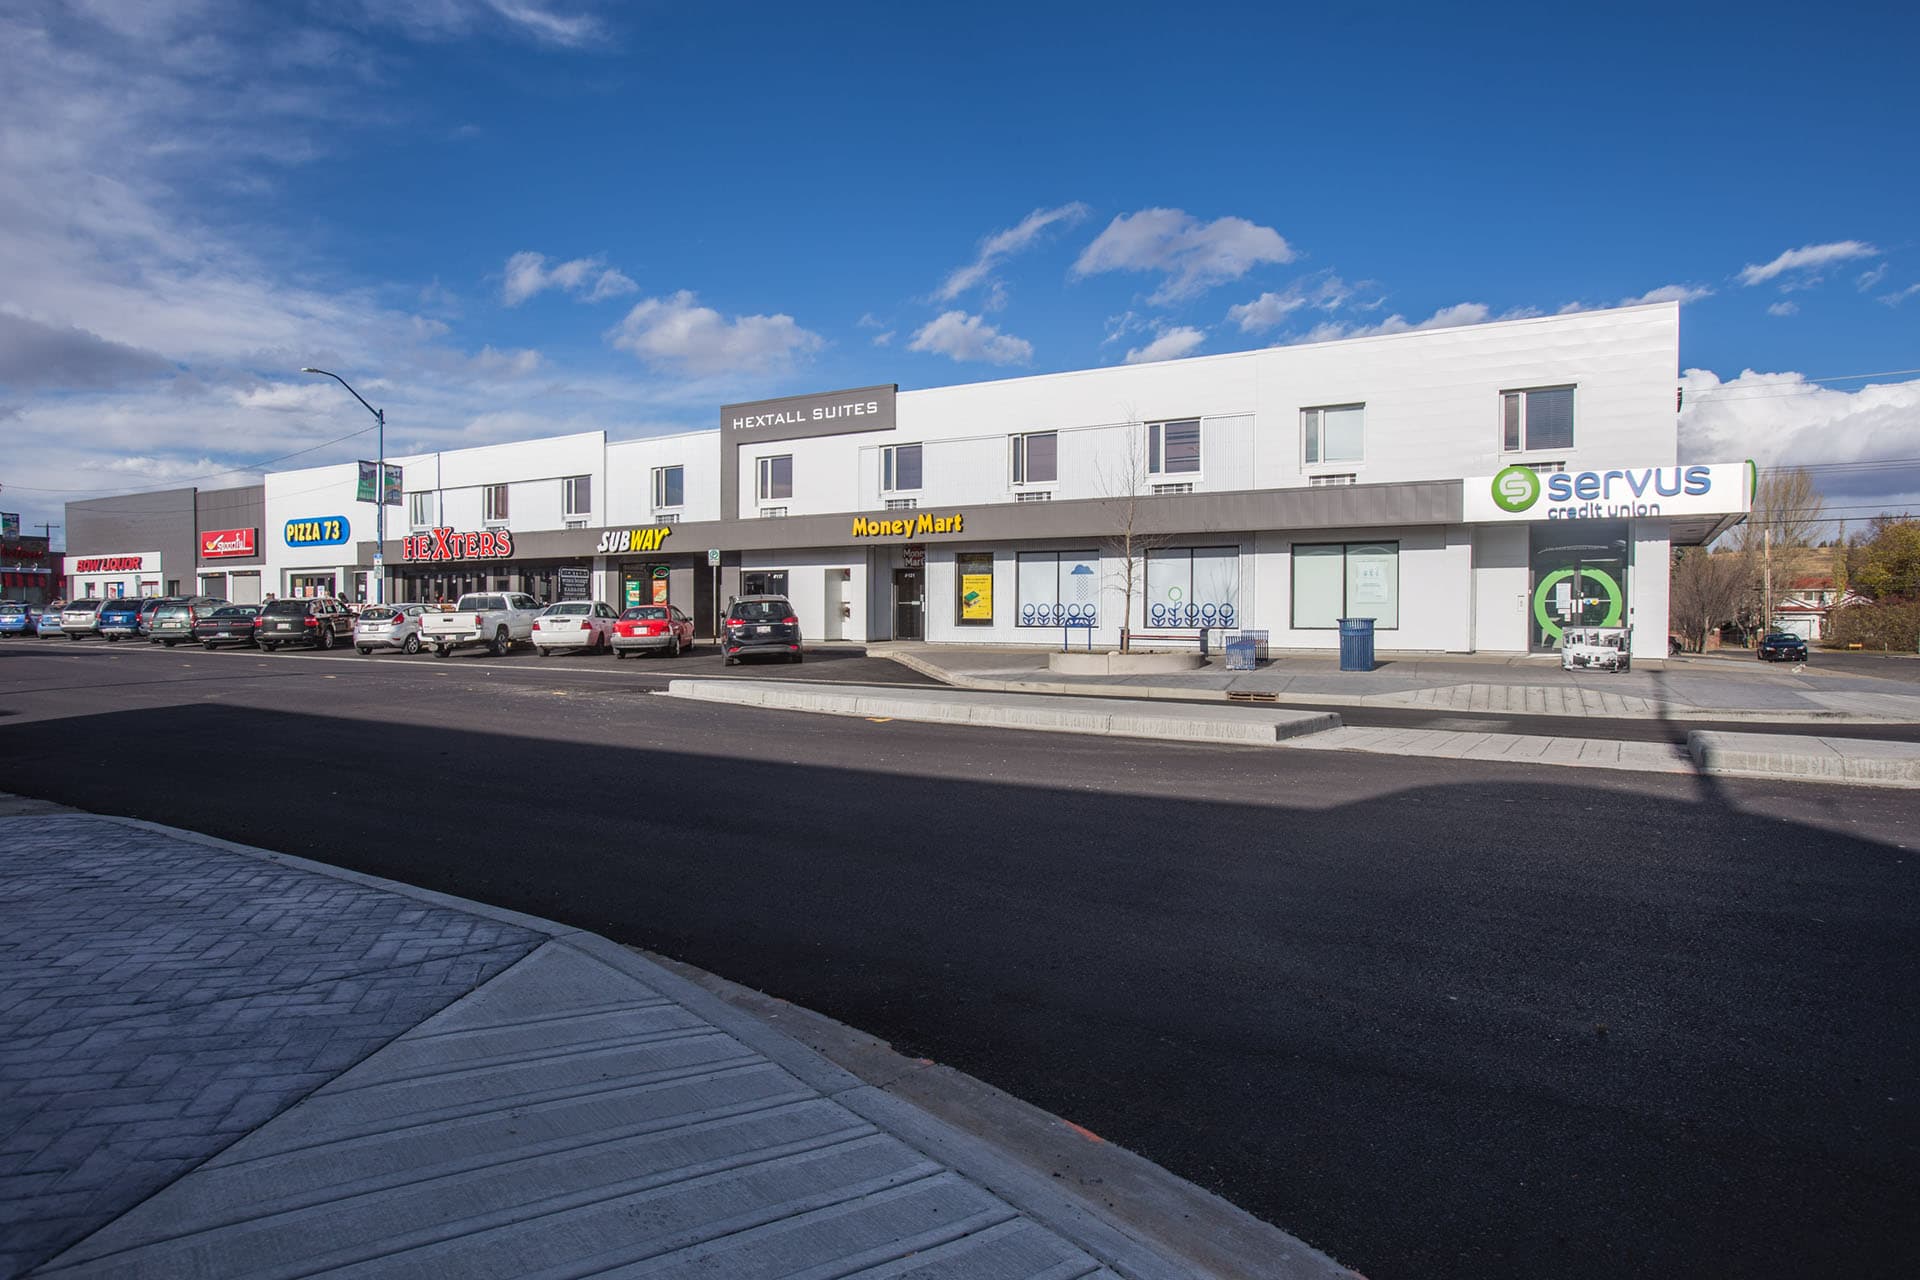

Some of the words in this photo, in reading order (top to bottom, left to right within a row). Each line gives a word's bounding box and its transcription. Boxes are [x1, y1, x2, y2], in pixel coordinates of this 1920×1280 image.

[733, 410, 806, 430] HEXTALL
[812, 401, 878, 421] SUITES
[1548, 465, 1711, 502] servus
[1547, 502, 1603, 520] credit
[1607, 501, 1660, 518] union
[287, 522, 321, 542] PIZZA
[323, 520, 341, 540] 73
[852, 516, 915, 538] Money
[917, 513, 963, 533] Mart
[402, 527, 512, 560] HEXTERS
[596, 526, 671, 553] SUBWAY
